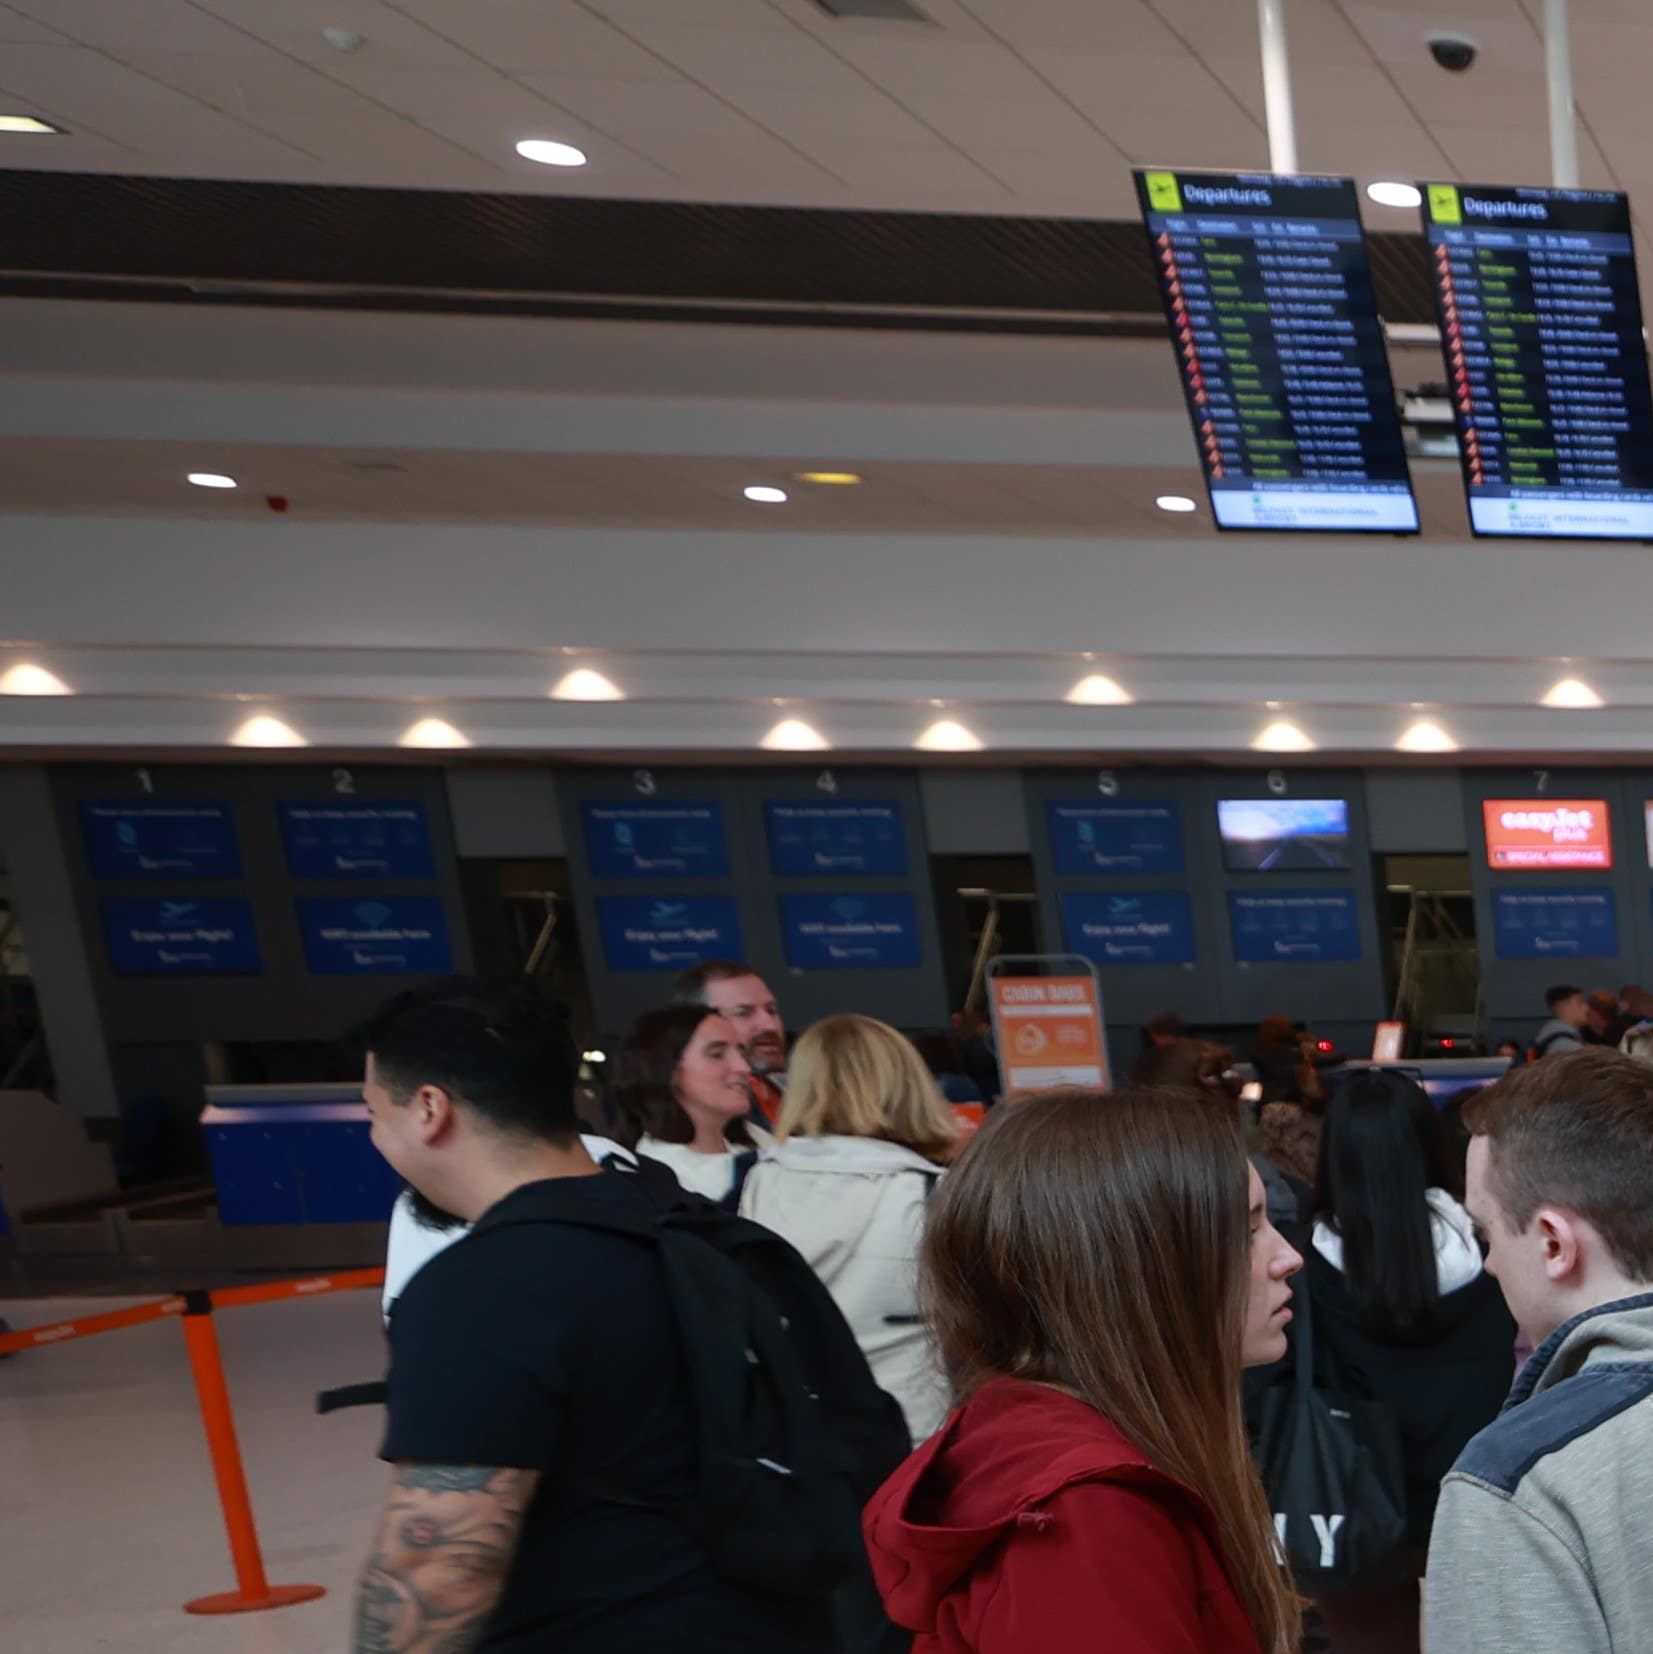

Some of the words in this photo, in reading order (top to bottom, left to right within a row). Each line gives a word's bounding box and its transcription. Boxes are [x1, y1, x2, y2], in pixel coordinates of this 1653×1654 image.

[1183, 183, 1273, 206] Departures
[1464, 197, 1548, 219] Departures
[332, 769, 356, 793] 2
[634, 769, 657, 795] 3
[816, 770, 839, 795] 4
[1532, 771, 1548, 792] 7
[1501, 807, 1594, 832] easyJet
